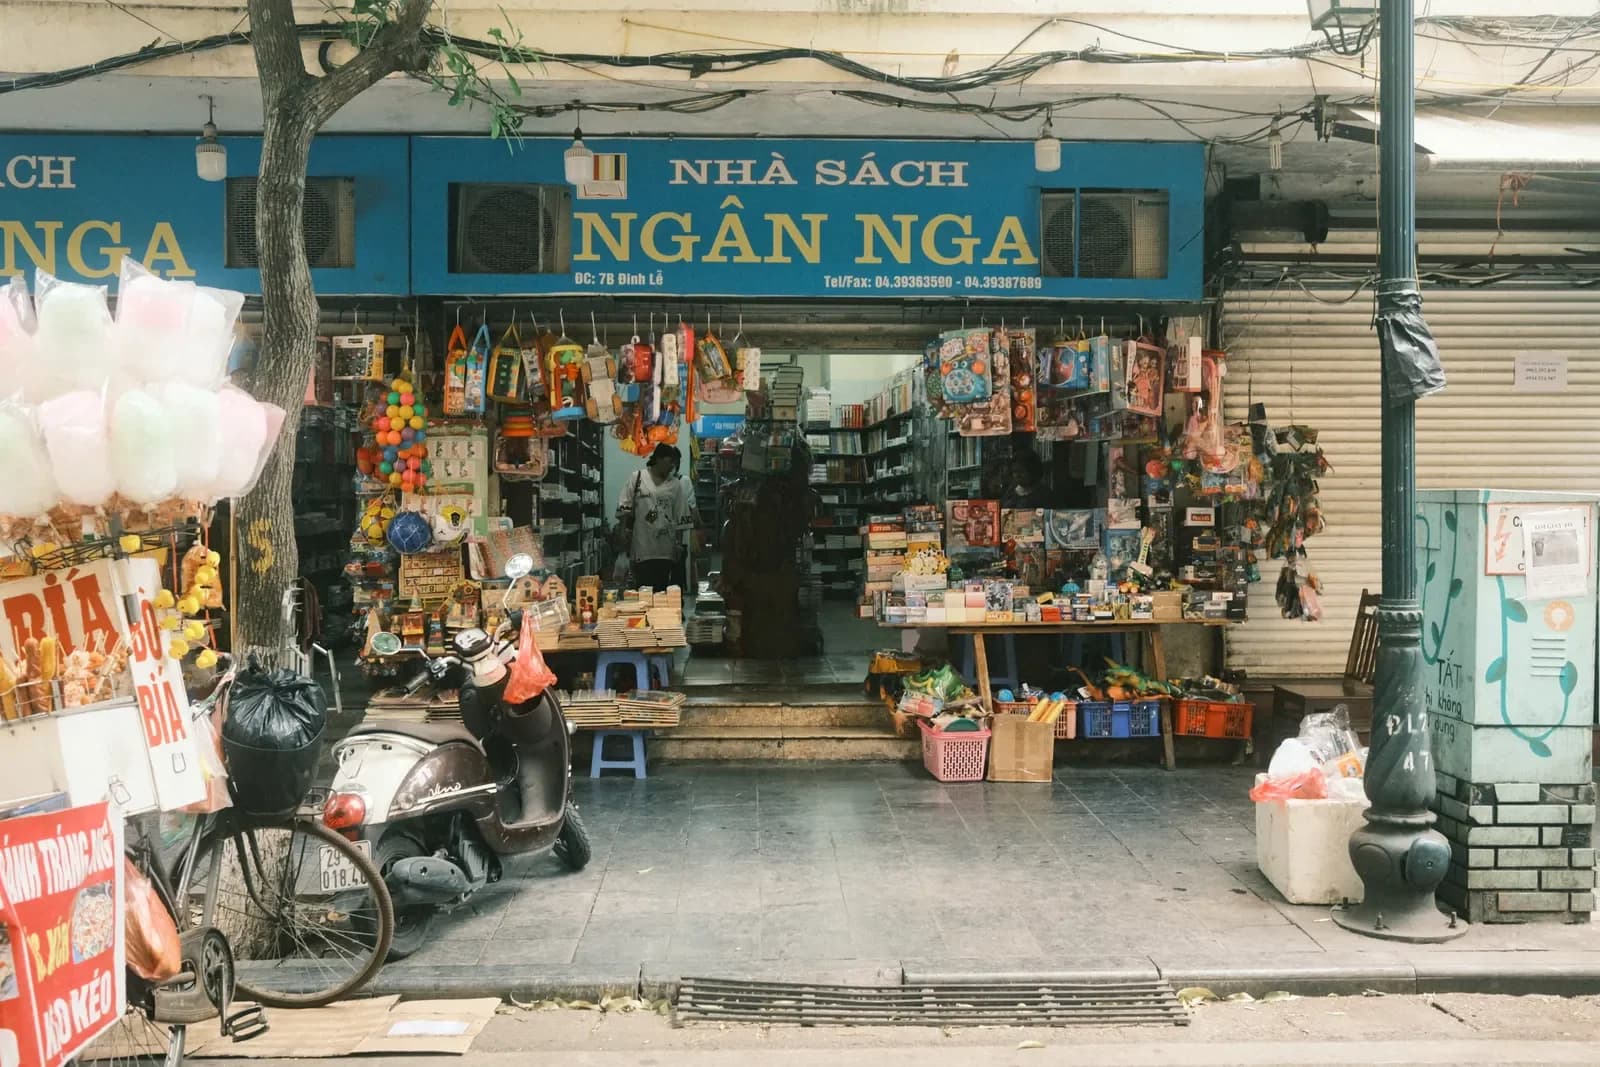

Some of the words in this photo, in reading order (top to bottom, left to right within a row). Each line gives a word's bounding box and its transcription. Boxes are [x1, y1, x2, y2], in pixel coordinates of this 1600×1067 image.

[0, 154, 76, 189] CH
[669, 152, 798, 185] NHÀ
[815, 152, 968, 187] SÁCH
[573, 195, 828, 265] NGÂN
[854, 213, 1039, 266] NGA
[0, 219, 197, 279] NGA
[574, 271, 596, 286] ĐC:
[598, 272, 615, 286] 7B
[824, 275, 872, 289] Tel/Fax:
[1423, 685, 1433, 706] hi
[1438, 688, 1462, 719] không
[69, 968, 113, 1034] KÉO
